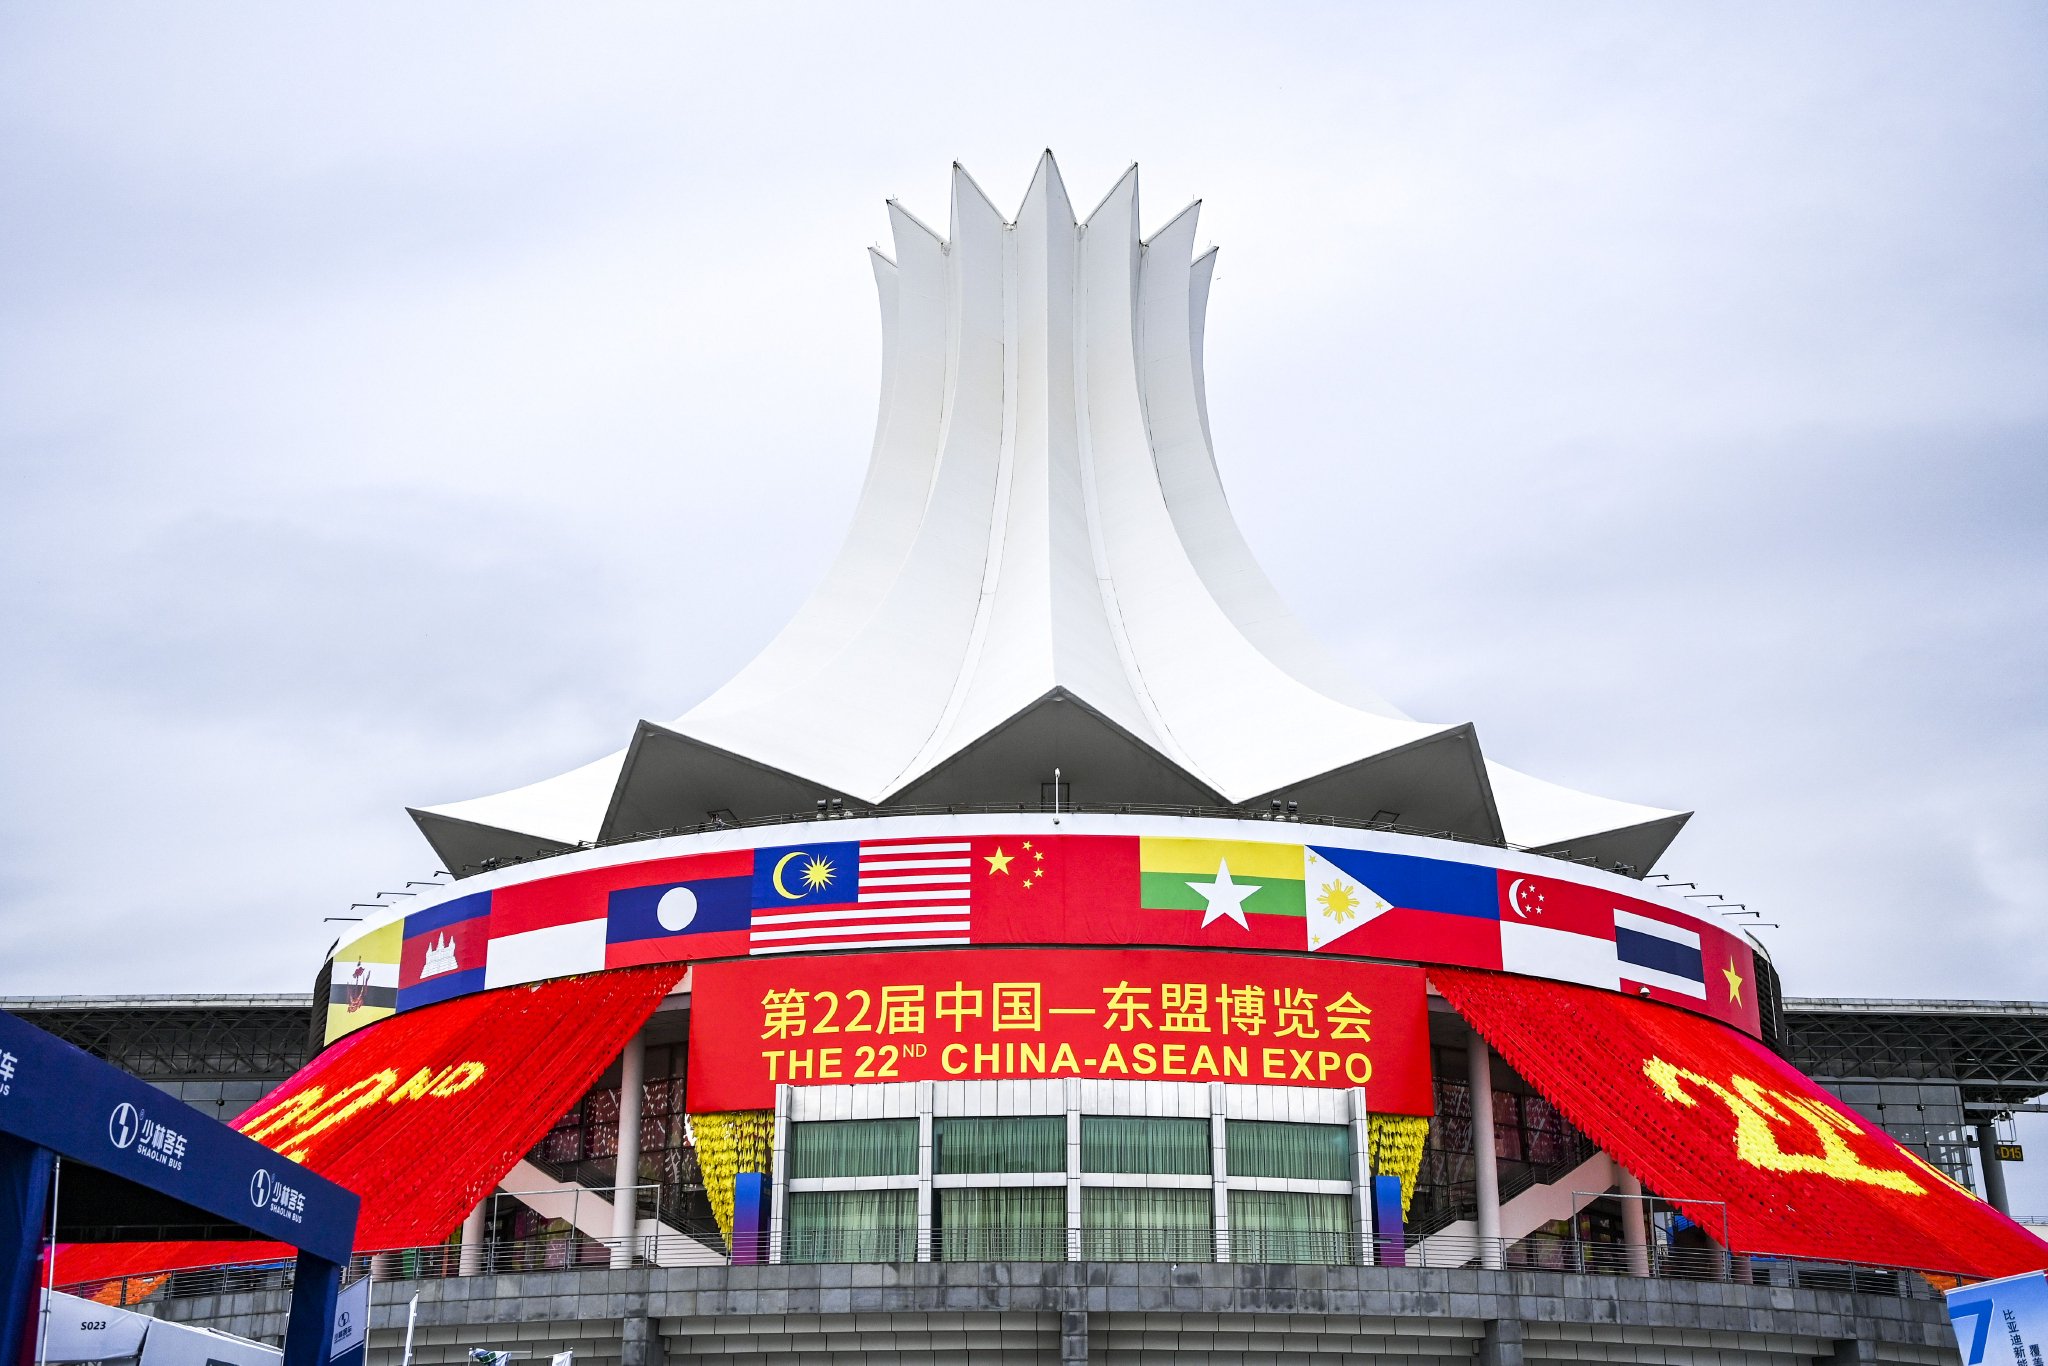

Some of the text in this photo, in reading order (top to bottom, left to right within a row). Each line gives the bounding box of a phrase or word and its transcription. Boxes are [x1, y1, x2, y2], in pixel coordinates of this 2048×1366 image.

[0, 1049, 18, 1081] 车
[761, 1047, 843, 1081] THE
[941, 1042, 1249, 1078] CHINA-ASEAN
[1263, 1047, 1373, 1084] EXPO
[140, 1119, 188, 1159] 少林客车
[2000, 1146, 2022, 1159] D15
[137, 1144, 183, 1171] SHAOLIN BUS
[80, 1321, 107, 1331] S023
[1948, 1298, 1995, 1366] 7
